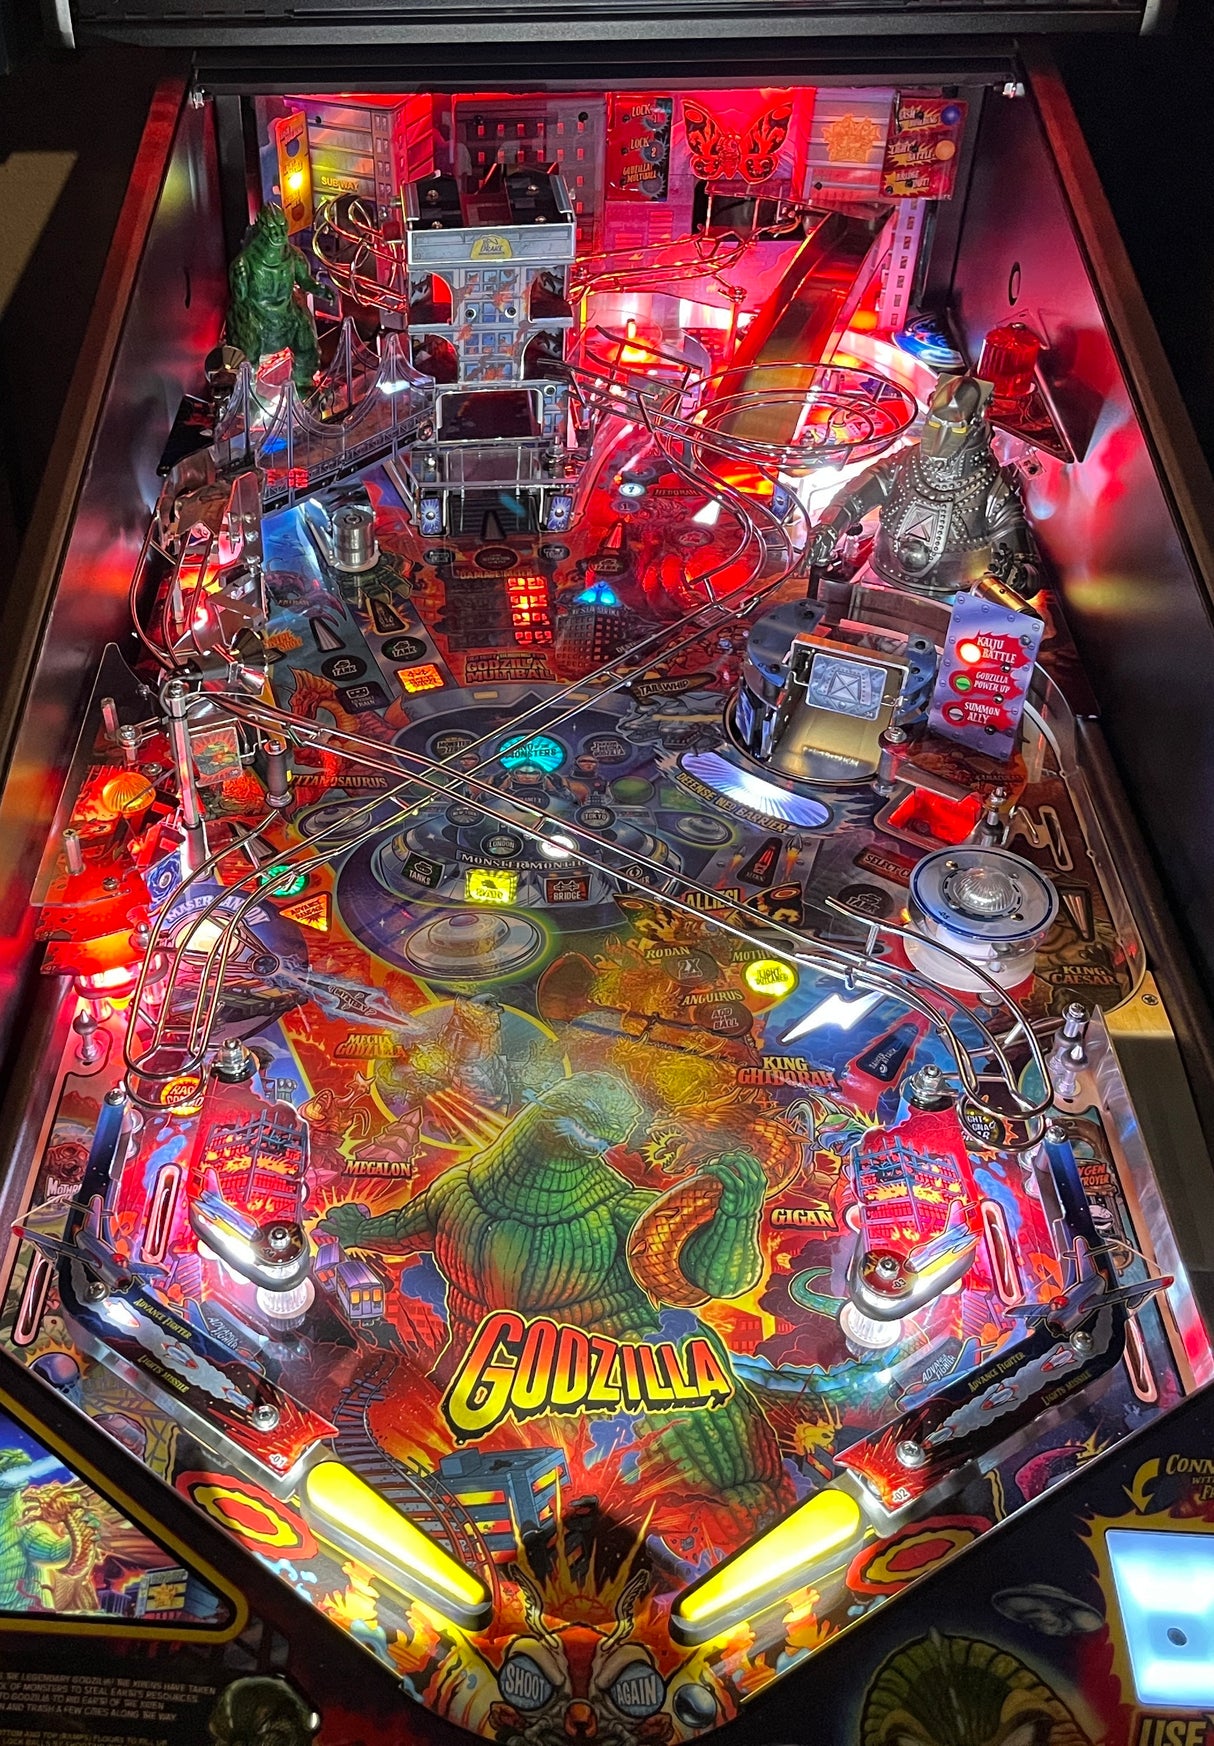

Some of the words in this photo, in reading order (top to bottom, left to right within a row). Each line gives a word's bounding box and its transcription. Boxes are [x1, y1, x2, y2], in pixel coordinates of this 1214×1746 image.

[632, 104, 652, 117] LOCK
[630, 136, 650, 149] LOCK
[651, 147, 657, 157] 2
[321, 176, 359, 191] SUBWAY
[977, 637, 1005, 651] KAIJU
[982, 647, 1017, 664] BATTLE
[467, 658, 546, 672] GODZILLA
[467, 669, 556, 682] MULTIBALL
[975, 671, 1009, 684] GODZILLA
[639, 683, 661, 696] TAIL
[663, 680, 689, 693] WHIP
[973, 679, 997, 692] POWER
[998, 685, 1010, 694] UP
[964, 702, 1000, 716] SUMMON
[967, 712, 990, 724] ALLY
[289, 775, 388, 788] TITANOSAURUS
[676, 773, 717, 800] DEFENSE
[715, 797, 736, 811] NEO
[735, 808, 790, 834] BARRIER
[583, 812, 608, 822] TOKYO
[488, 840, 515, 850] LONDON
[864, 853, 901, 874] SELECT
[408, 868, 431, 886] TANKS
[553, 890, 581, 900] BRIDGE
[166, 895, 215, 923] MASER
[645, 946, 691, 959] RODAN
[1063, 965, 1106, 976] KING
[1052, 973, 1117, 985] CAESAR
[681, 989, 744, 1006] ANGUIRUS
[711, 1008, 733, 1020] ADD
[713, 1018, 739, 1030] BALL
[762, 1056, 809, 1072] KING
[737, 1068, 837, 1089] GHIDORAH
[346, 1160, 412, 1177] MEGALON
[771, 1209, 837, 1229] GIGAN
[133, 1297, 166, 1327] ADVANCE
[164, 1316, 193, 1340] FIGHTER
[136, 1354, 163, 1378] LIGHTS
[444, 1310, 735, 1433] GODZILLA
[967, 1367, 1000, 1393] ADVANCE
[997, 1351, 1026, 1374] FIGHTER
[894, 1488, 908, 1501] -02
[504, 1666, 545, 1702] SHOOT
[614, 1674, 657, 1708] AGAIN
